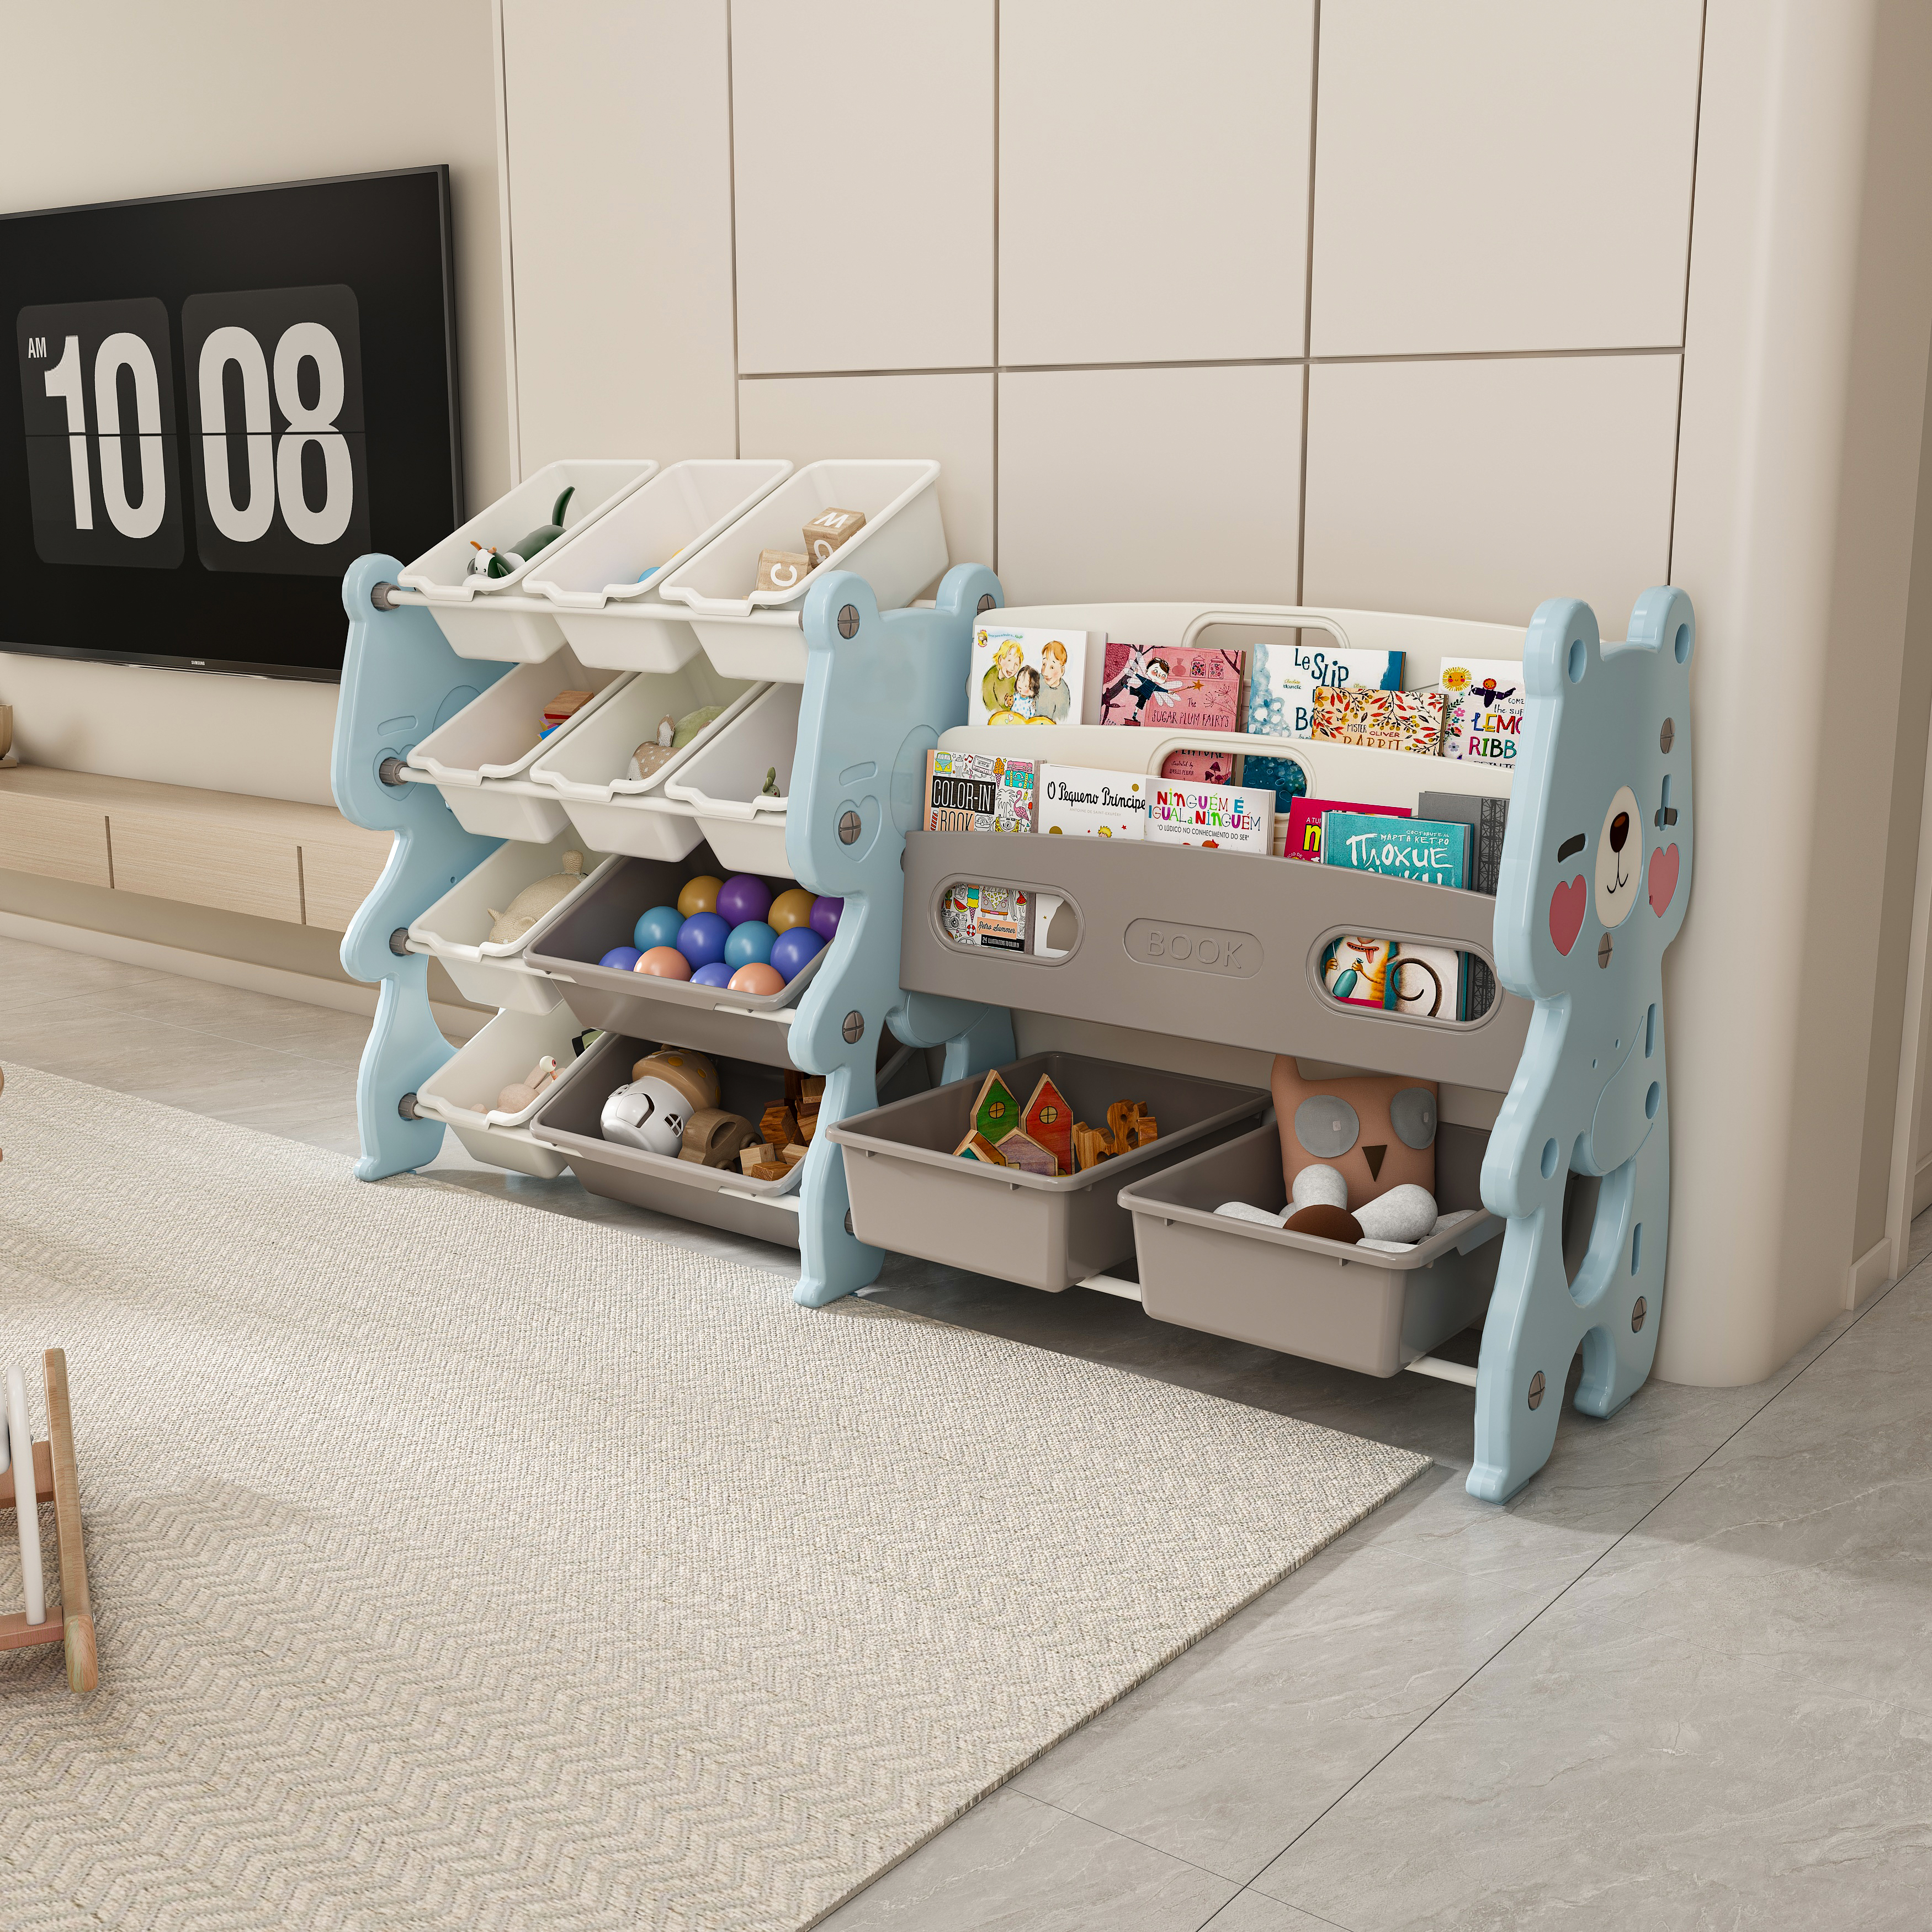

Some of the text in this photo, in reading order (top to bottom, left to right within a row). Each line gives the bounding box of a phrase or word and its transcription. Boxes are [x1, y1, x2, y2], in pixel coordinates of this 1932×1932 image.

[28, 337, 47, 358] AM
[44, 321, 353, 545] 10 08
[813, 512, 850, 528] M
[770, 562, 798, 587] C
[1294, 647, 1310, 670] Le
[1187, 697, 1197, 708] The
[1494, 704, 1507, 713] the
[1152, 710, 1229, 728] SUGAR PLUM FAIRY'S
[1347, 724, 1367, 733] MISTER
[1047, 781, 1056, 800] O
[1058, 782, 1099, 807] Pequeno
[1148, 805, 1187, 823] IGUAL
[1234, 797, 1244, 814] É
[1192, 828, 1229, 839] CONHECIMENTO
[1380, 834, 1449, 845] МАРТА КЕТРО
[978, 921, 1016, 934] Retro Summer
[1147, 930, 1243, 969] BOOK
